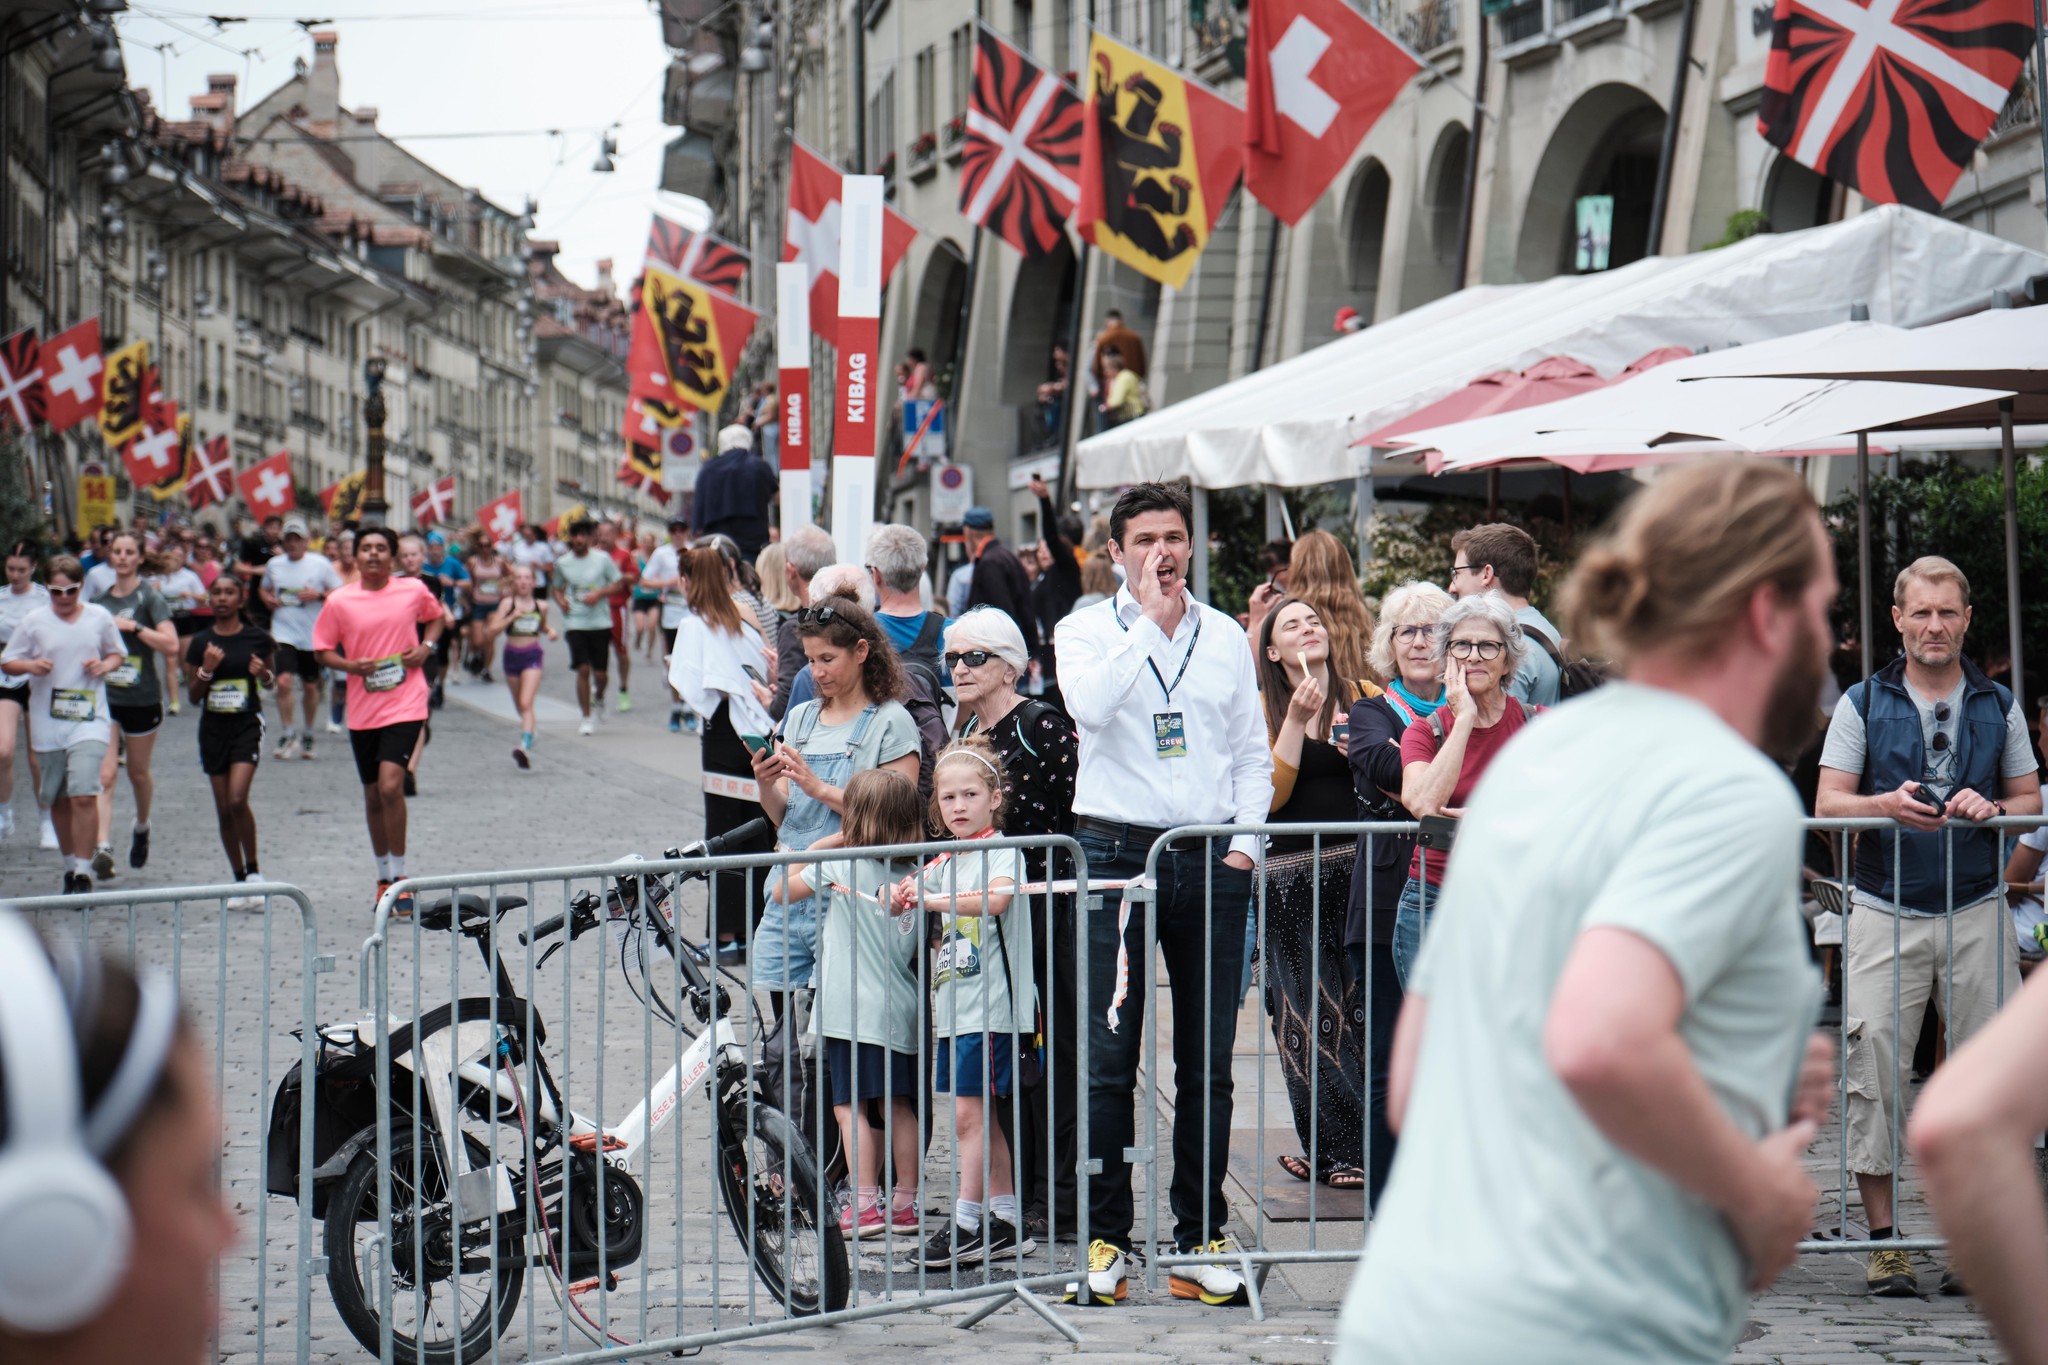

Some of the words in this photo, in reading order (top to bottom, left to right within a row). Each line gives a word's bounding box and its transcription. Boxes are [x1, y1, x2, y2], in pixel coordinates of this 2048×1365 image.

[847, 353, 867, 423] KIBAG
[787, 393, 802, 446] KIBAG
[1159, 738, 1184, 746] CREW
[649, 1100, 671, 1127] IESE
